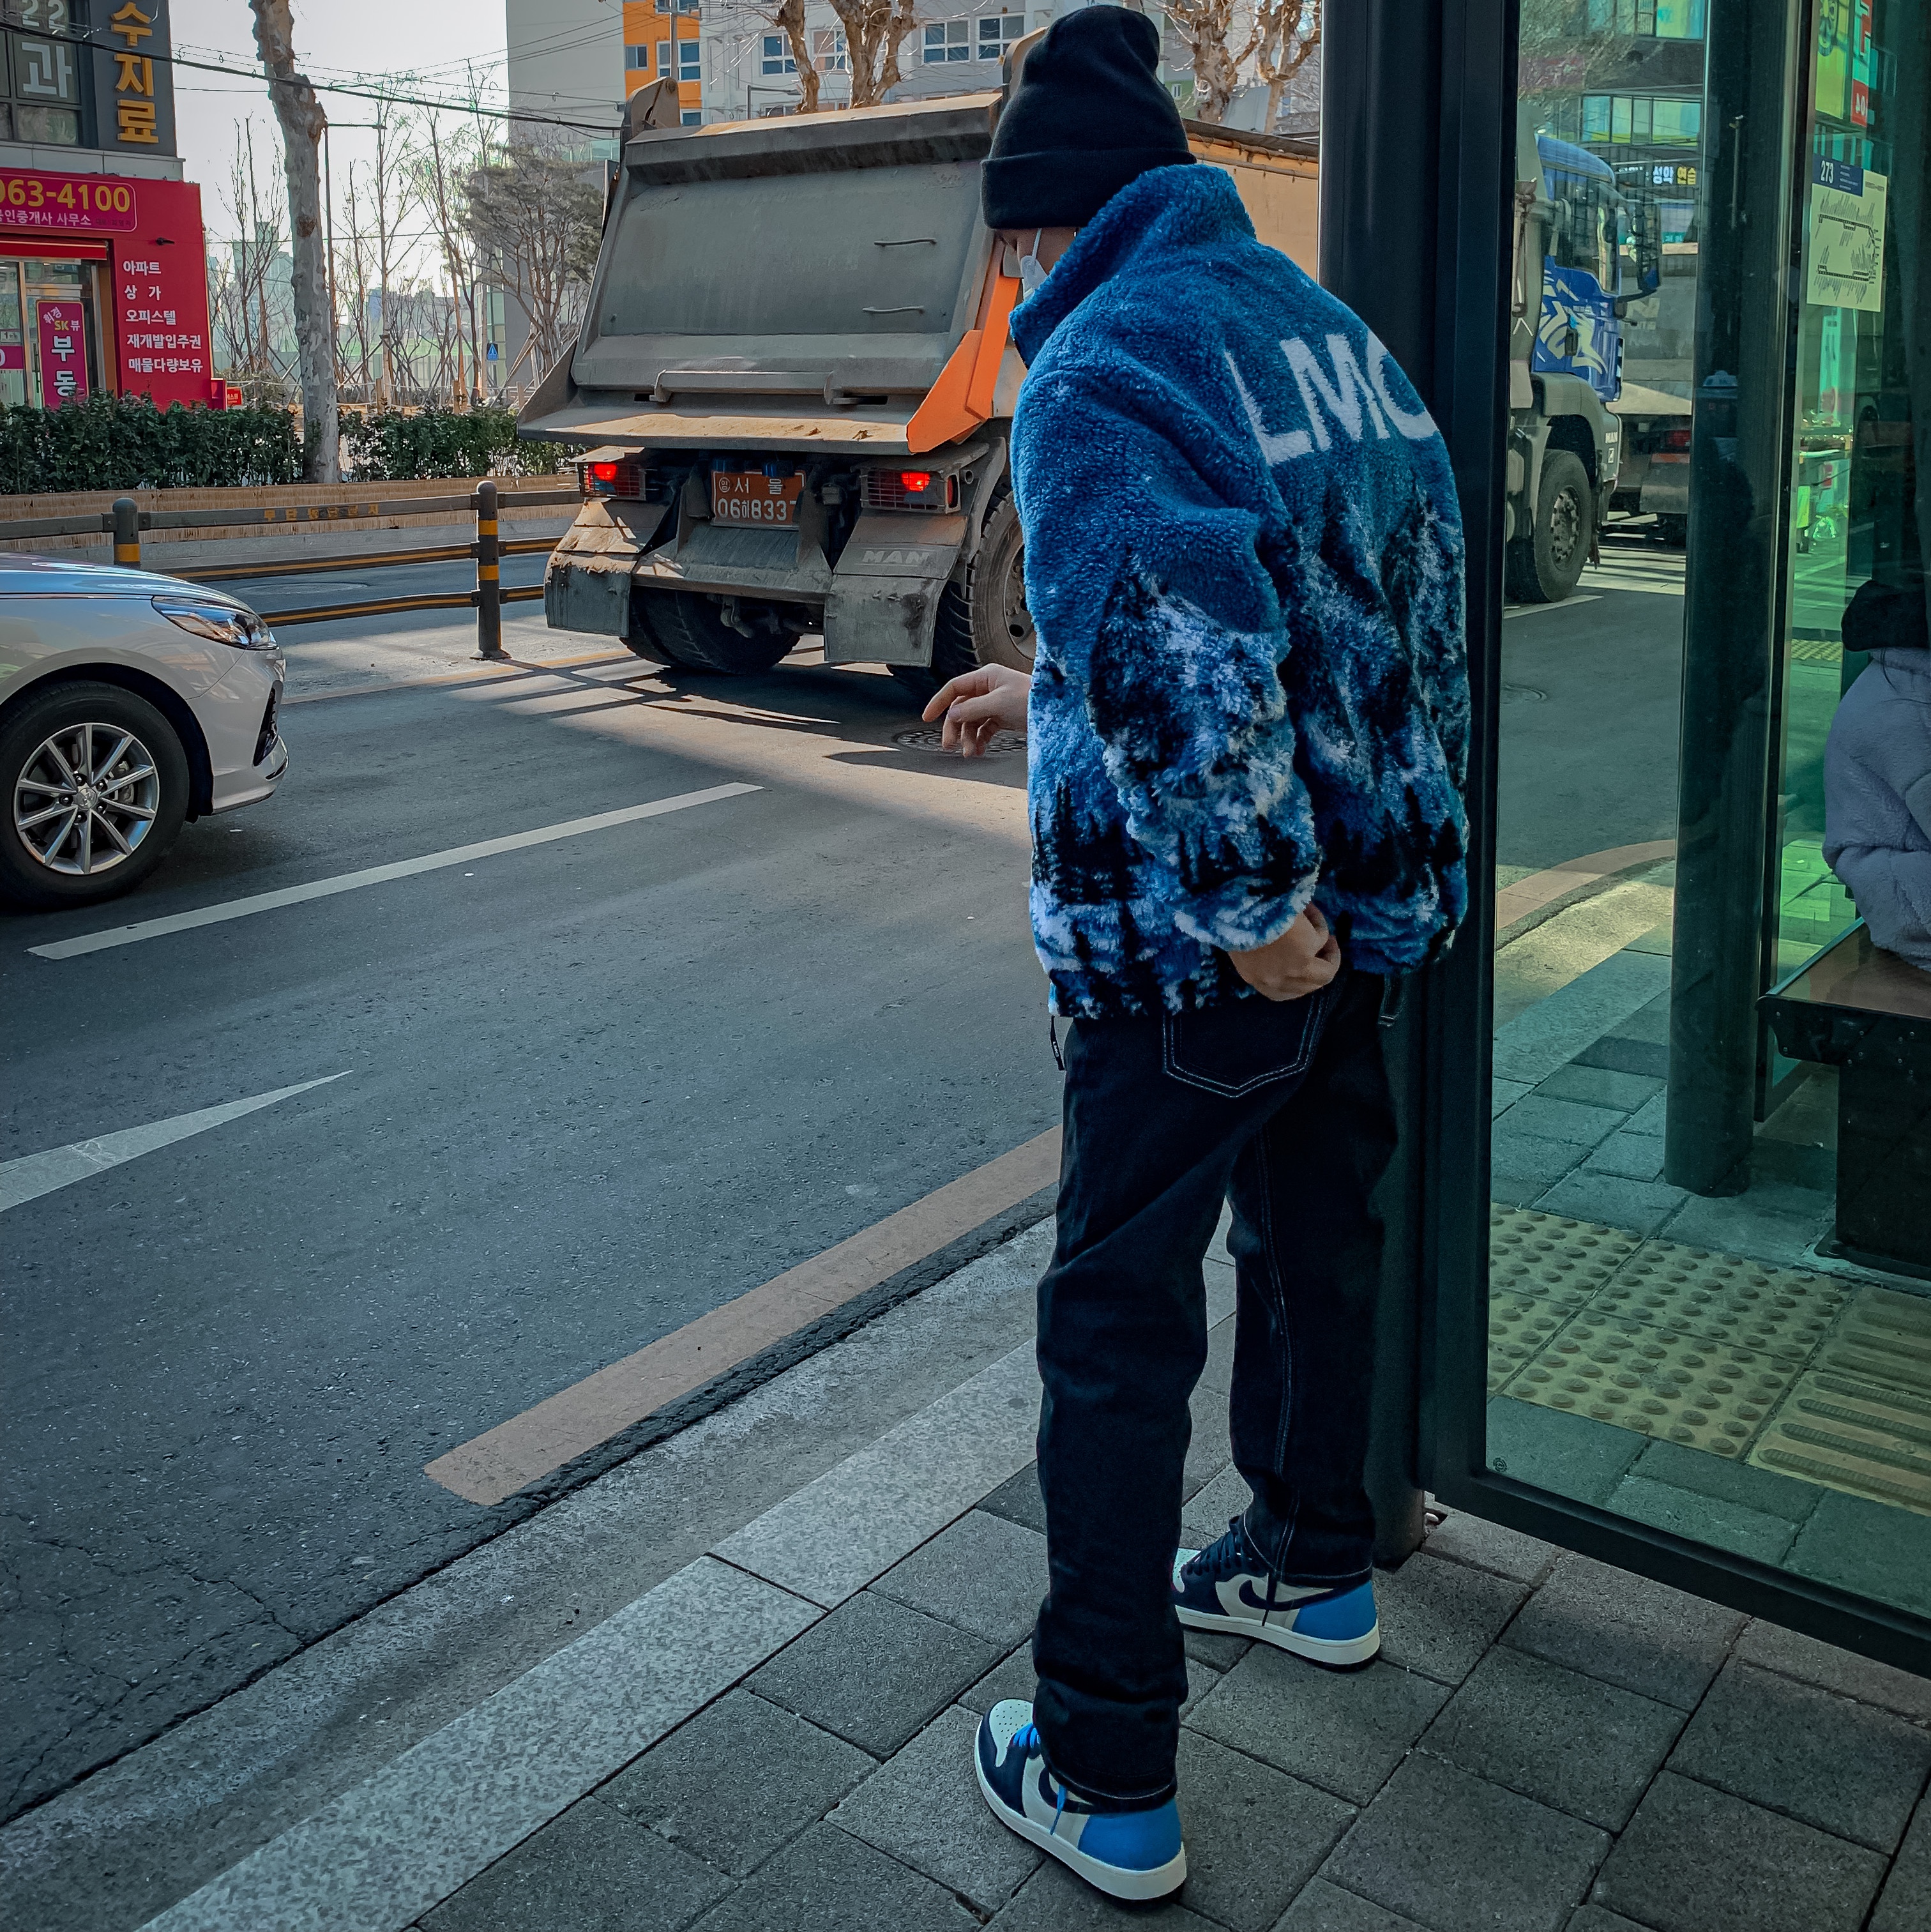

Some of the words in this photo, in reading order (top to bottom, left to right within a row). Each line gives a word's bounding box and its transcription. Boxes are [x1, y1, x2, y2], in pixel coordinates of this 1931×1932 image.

[21, 42, 72, 98] 과
[1820, 160, 1834, 184] 273
[0, 209, 52, 225] 인중개사
[57, 213, 92, 226] 사무소
[123, 260, 162, 276] 아파트
[125, 309, 176, 325] 오피스텔
[126, 333, 202, 349] 재개발입주권
[128, 358, 203, 373] 매물다량보유
[862, 550, 930, 563] MAN
